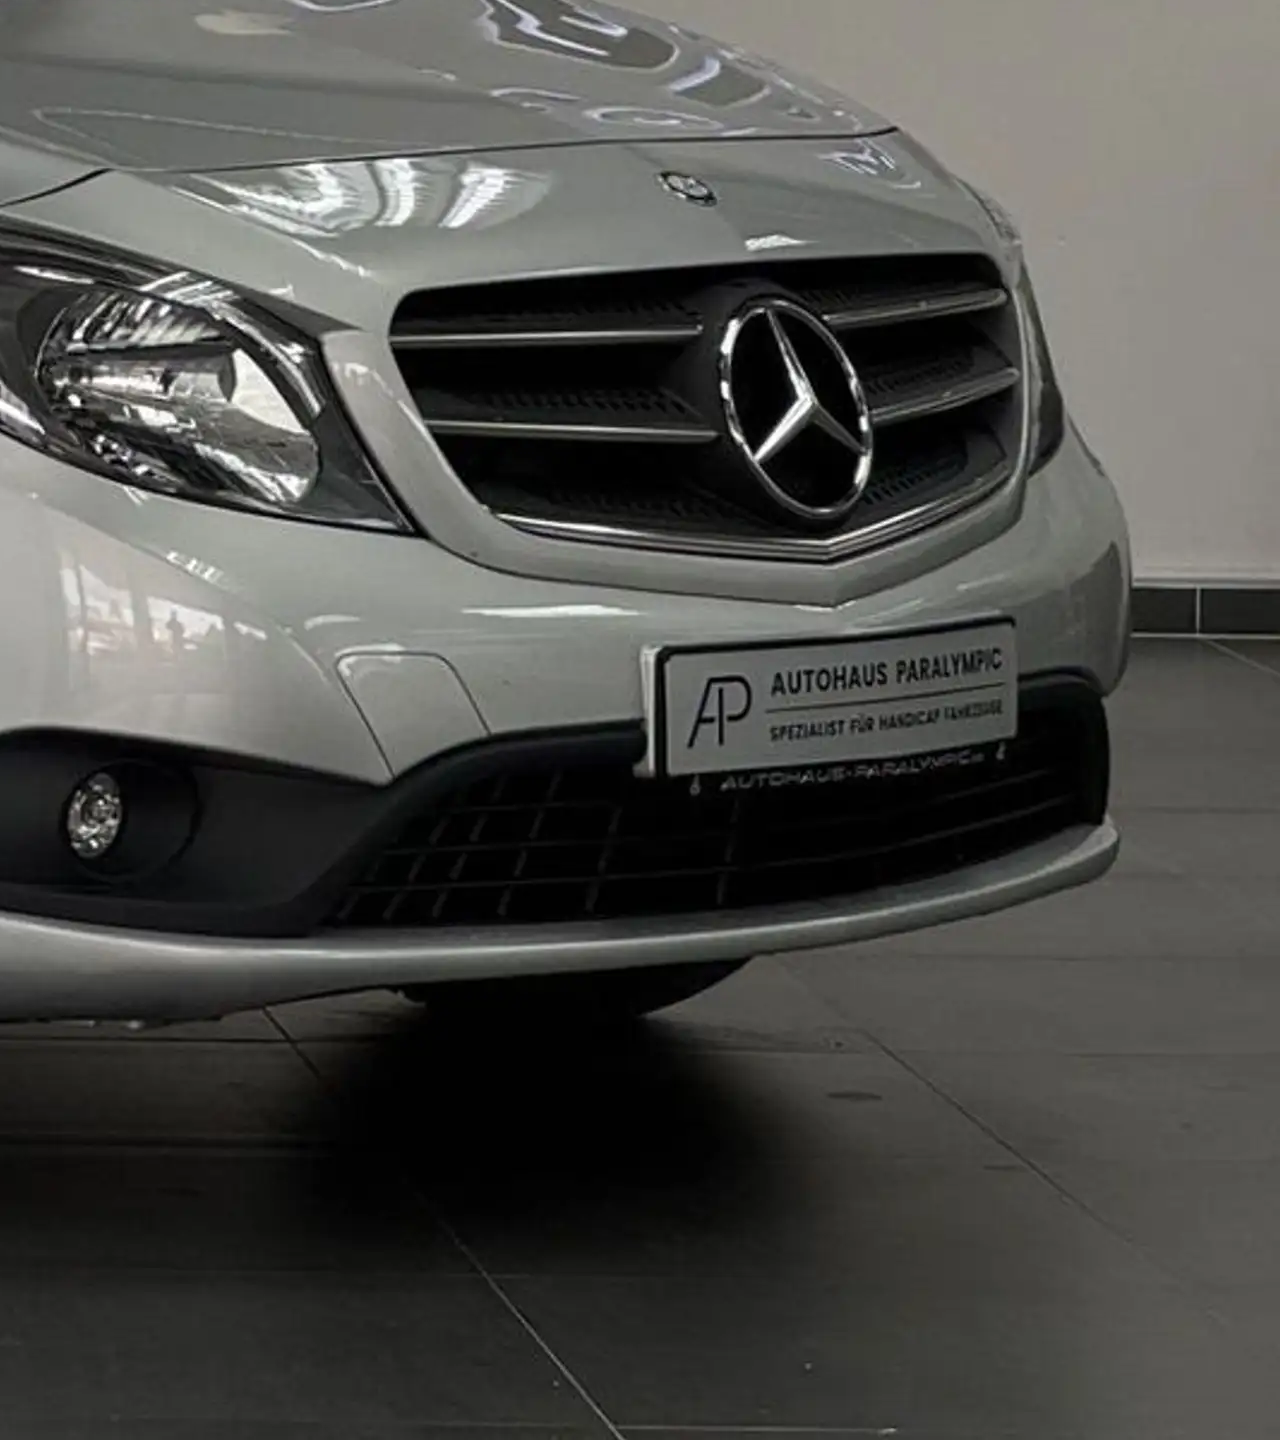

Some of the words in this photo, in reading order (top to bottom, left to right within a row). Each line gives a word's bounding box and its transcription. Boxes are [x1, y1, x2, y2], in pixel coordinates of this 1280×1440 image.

[770, 662, 888, 697] AUTOHAUS
[896, 647, 1003, 683] PARALYMPIC
[769, 719, 844, 742] SPEZIALIST
[849, 711, 874, 734] FÜR
